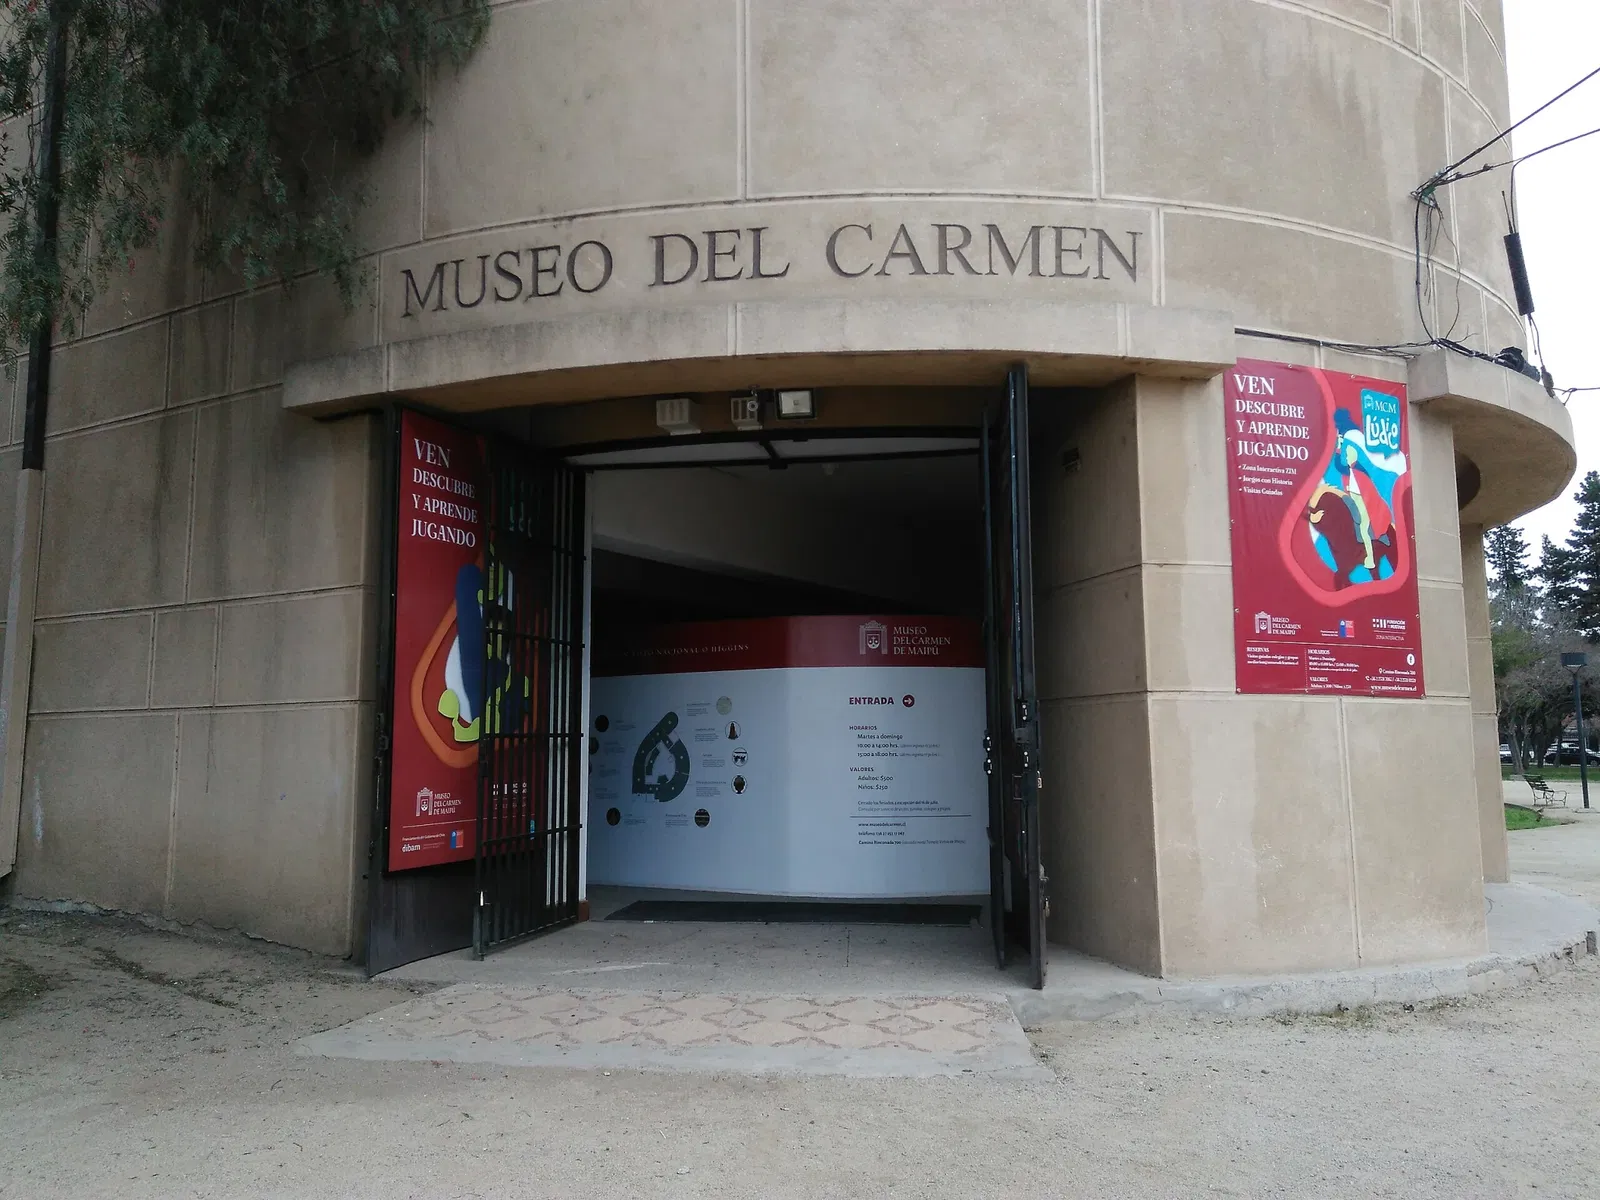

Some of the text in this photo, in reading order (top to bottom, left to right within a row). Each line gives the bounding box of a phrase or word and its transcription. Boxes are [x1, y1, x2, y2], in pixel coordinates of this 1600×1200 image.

[401, 223, 1142, 317] MUSEO DEL CARMEN
[1234, 374, 1275, 396] VEN
[1235, 399, 1305, 419] DESCUBRE
[1374, 401, 1396, 414] MCM
[1236, 420, 1310, 440] Y APRENDE
[413, 437, 450, 468] VEN
[1237, 440, 1309, 461] JUGANDO
[1242, 464, 1257, 472] Zona
[1257, 465, 1285, 474] Interactiva
[413, 468, 475, 499] DESCUBRE
[1243, 475, 1261, 484] Juegos
[1272, 478, 1293, 486] Historia
[1262, 488, 1283, 496] Guiadas
[412, 493, 478, 524] Y APRENDE
[411, 518, 476, 548] JUGANDO
[893, 626, 928, 635] MUSEO
[893, 636, 951, 645] DEL CARMEN
[893, 645, 940, 655] DE MAIPÚ
[849, 697, 895, 705] ENTRADA
[880, 733, 904, 741] domingo
[402, 843, 421, 853] dibam
